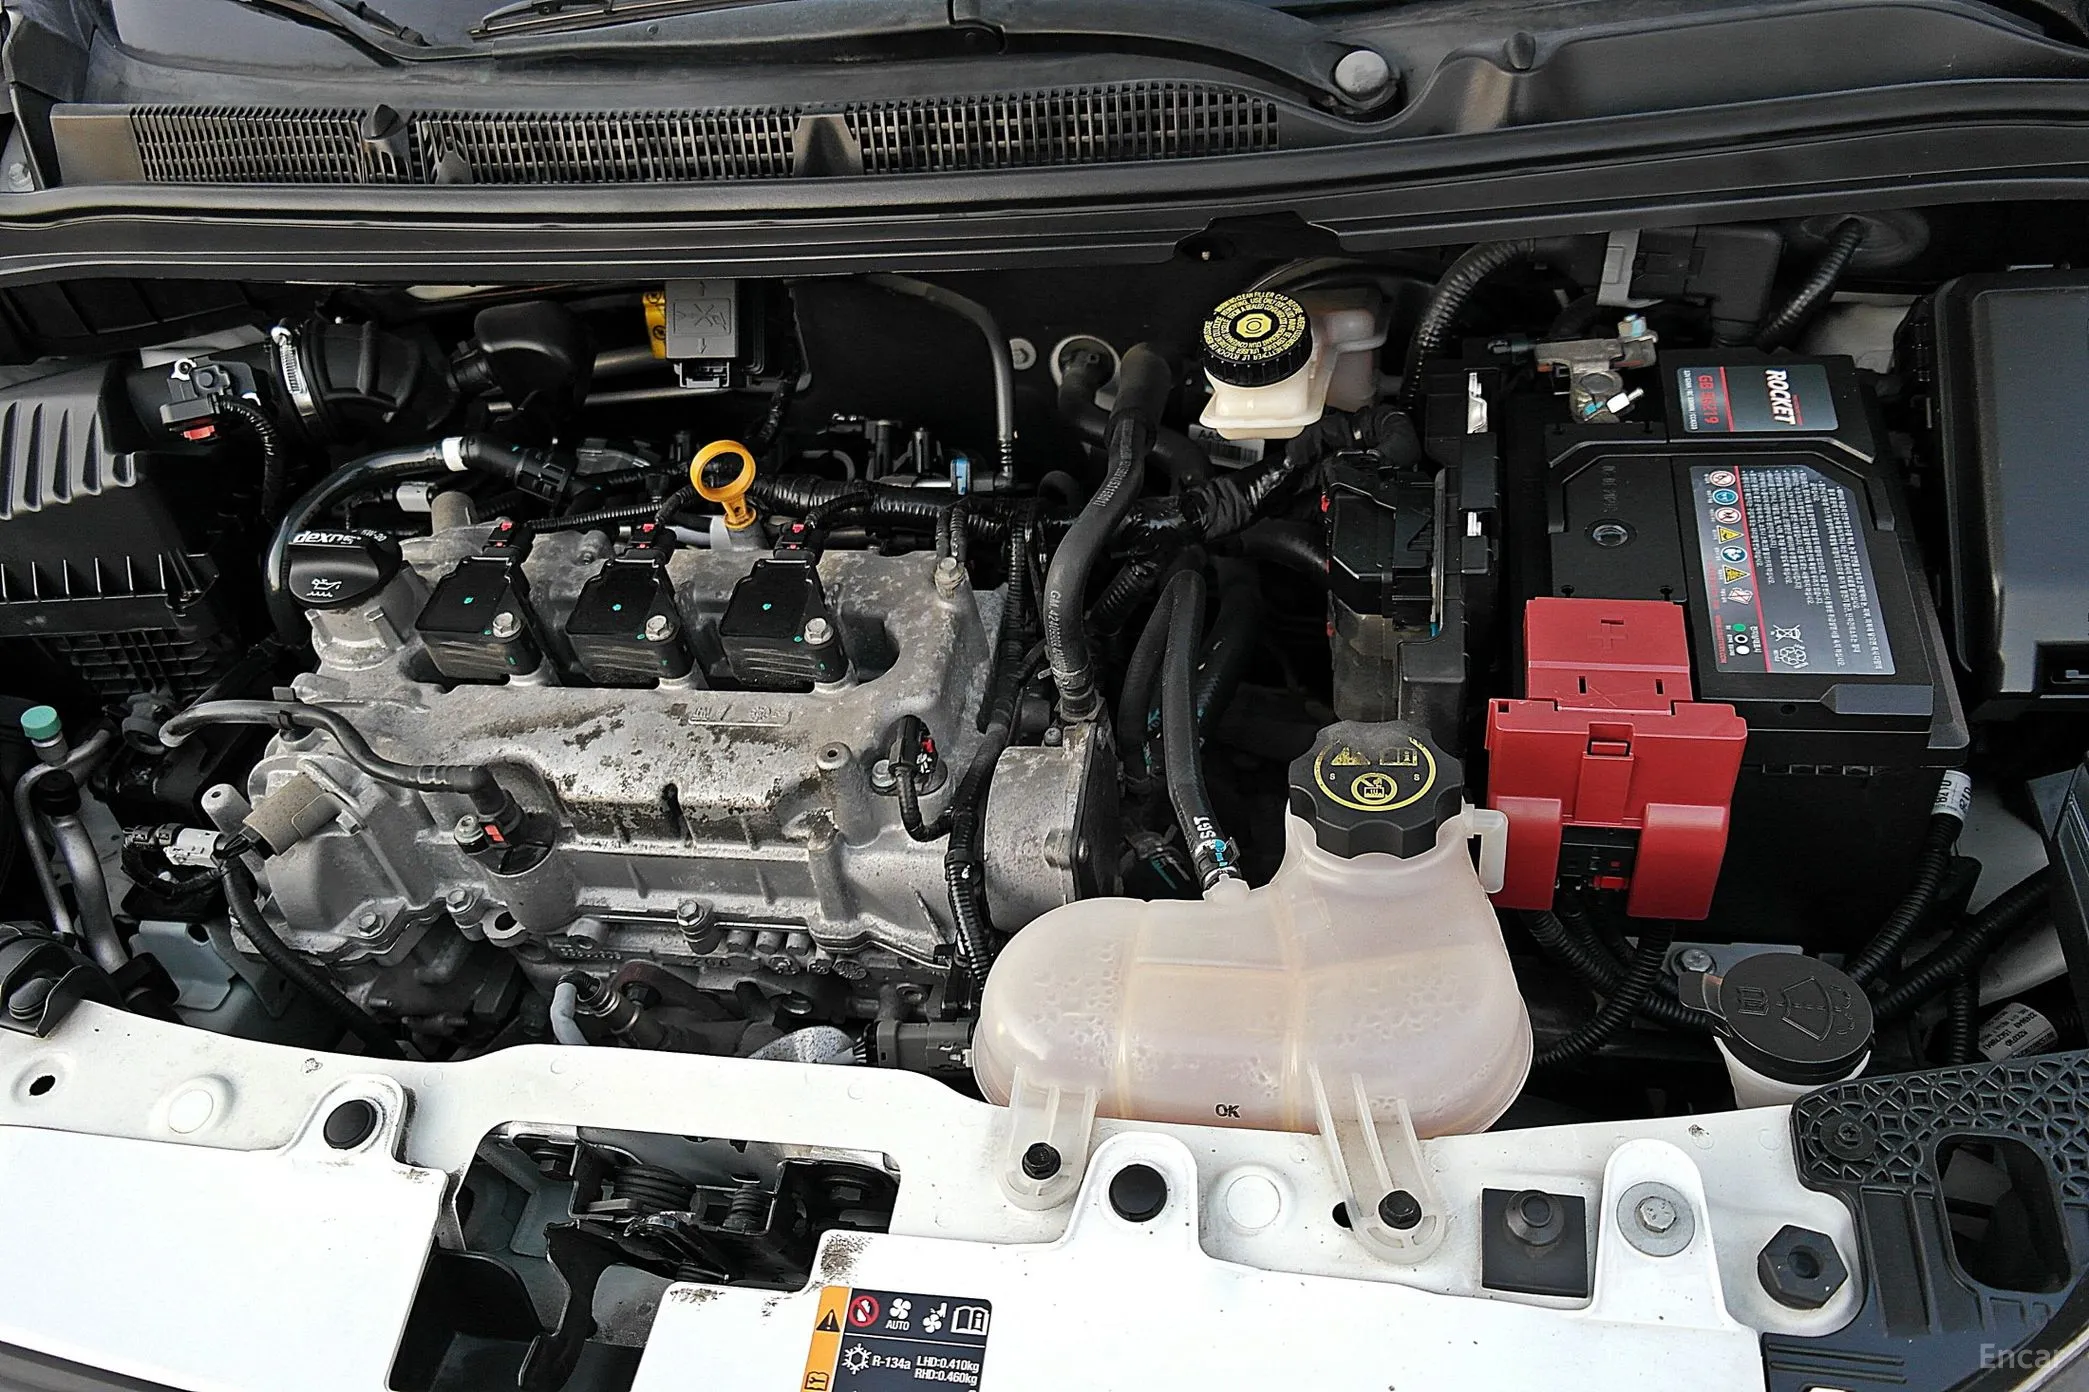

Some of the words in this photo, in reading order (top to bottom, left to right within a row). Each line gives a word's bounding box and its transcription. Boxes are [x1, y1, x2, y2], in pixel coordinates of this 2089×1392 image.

[1764, 369, 1797, 424] ROCKET
[1193, 815, 1217, 840] SGT
[1215, 1103, 1241, 1118] OK
[885, 1319, 911, 1332] AUTO
[871, 1355, 912, 1370] R-134a
[916, 1355, 980, 1373] LHD:0.410kg
[914, 1368, 979, 1386] RHD:0.460kg
